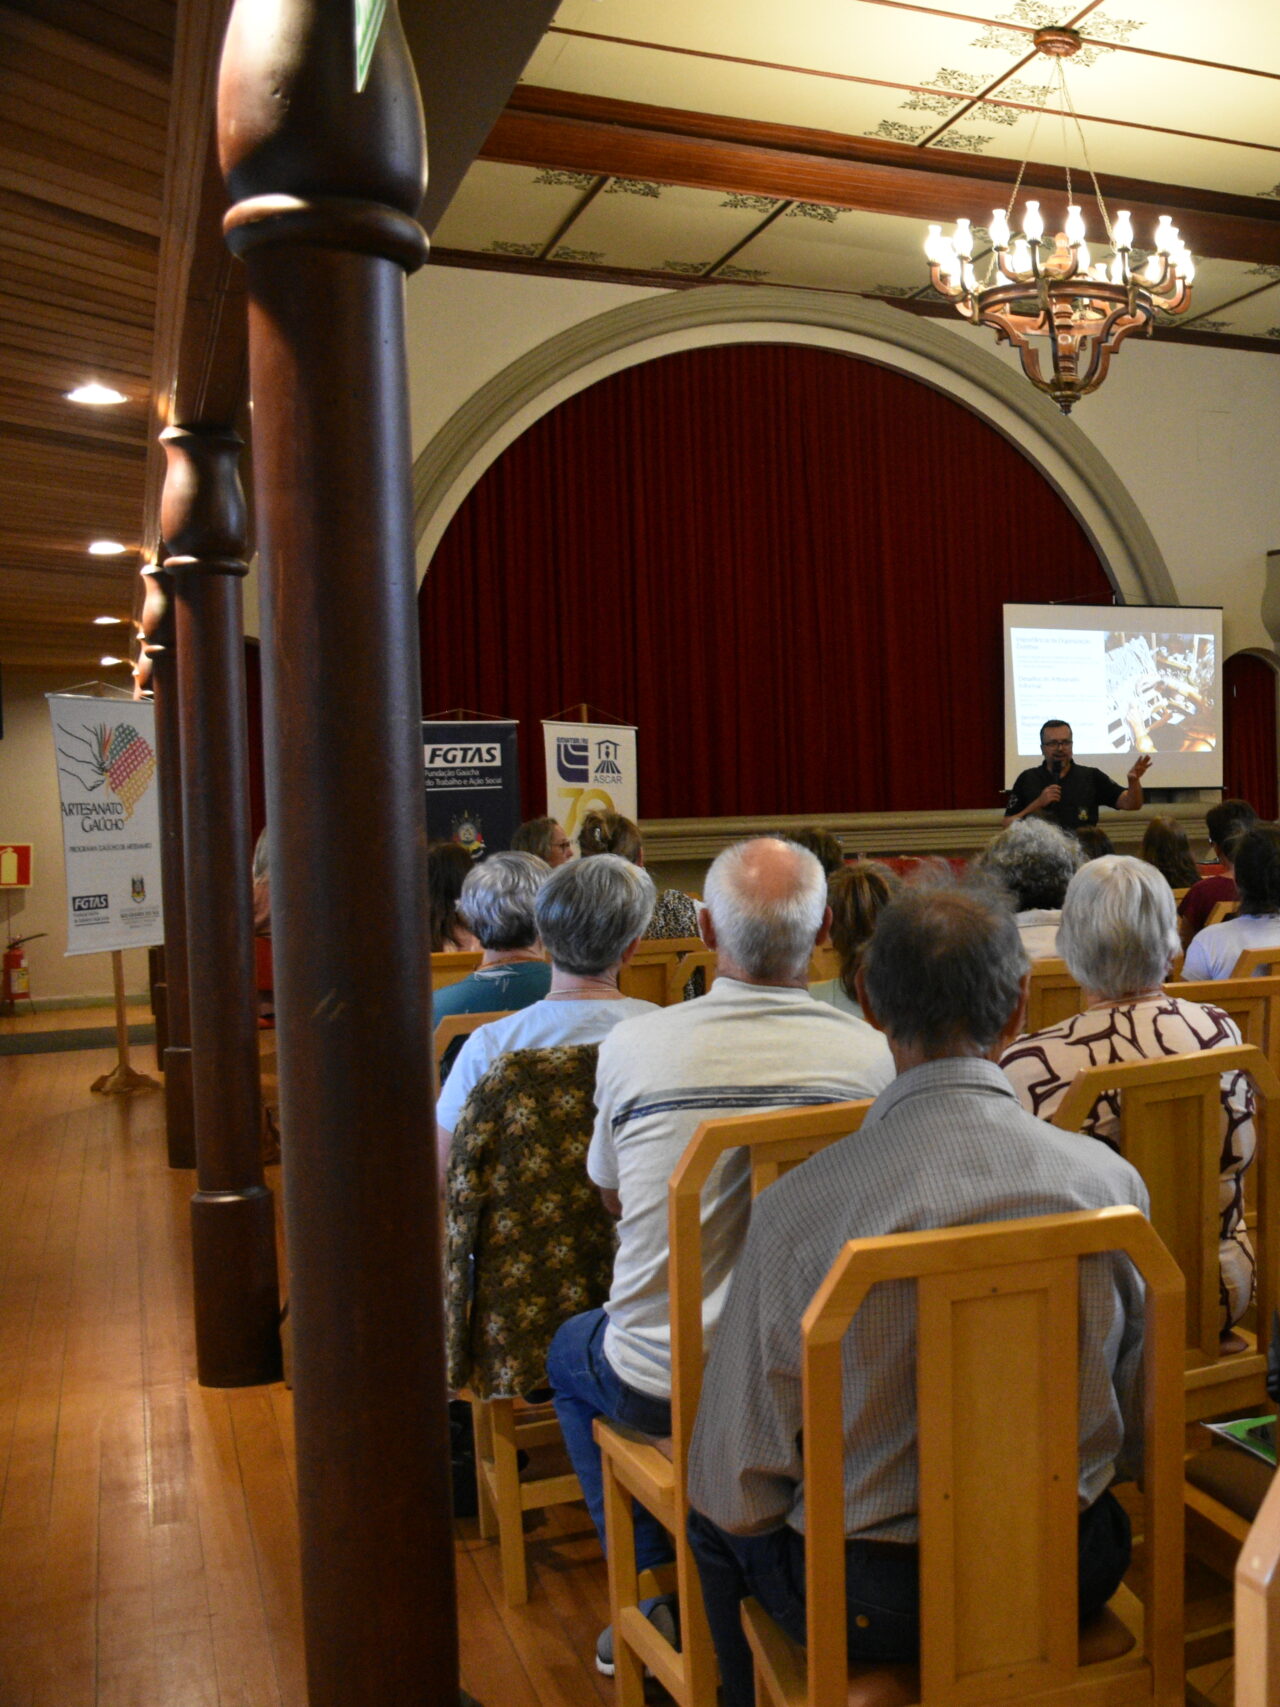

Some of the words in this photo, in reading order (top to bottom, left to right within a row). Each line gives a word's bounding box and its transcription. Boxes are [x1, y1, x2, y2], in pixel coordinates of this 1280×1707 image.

[428, 746, 497, 764] FGTAS
[593, 775, 622, 784] ASCAR
[61, 802, 123, 816] ARTESANATO
[81, 816, 124, 833] GAÚCHO
[75, 896, 107, 910] FGTAS
